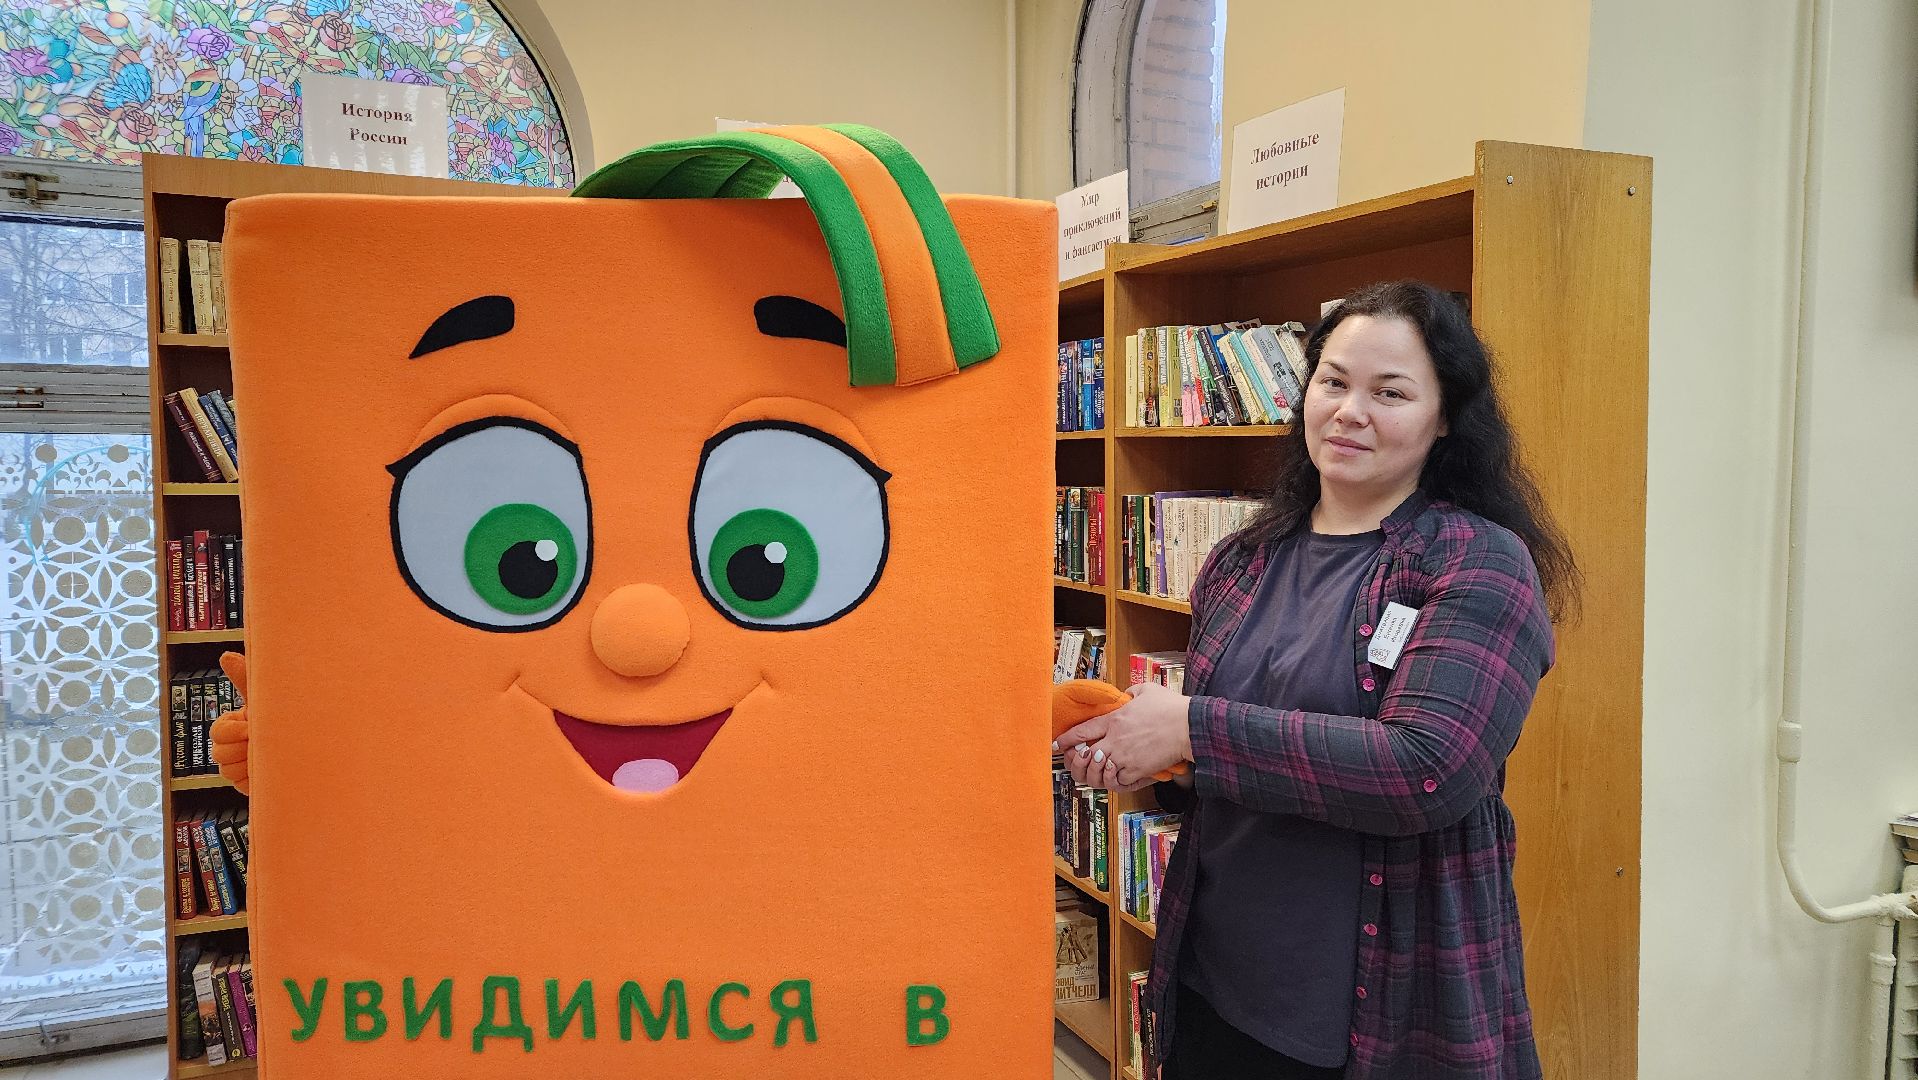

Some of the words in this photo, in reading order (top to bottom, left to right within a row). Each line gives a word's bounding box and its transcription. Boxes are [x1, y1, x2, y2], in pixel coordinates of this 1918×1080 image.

[341, 102, 413, 123] История
[349, 128, 408, 145] России
[1250, 131, 1320, 165] Любовные
[1255, 164, 1309, 190] истории
[1080, 193, 1100, 208] Мир
[1063, 206, 1121, 239] приключений
[1064, 251, 1071, 261] и
[1056, 977, 1075, 987] ЭВИД
[282, 974, 818, 1053] УВИДИМСЯ
[905, 984, 950, 1048] В
